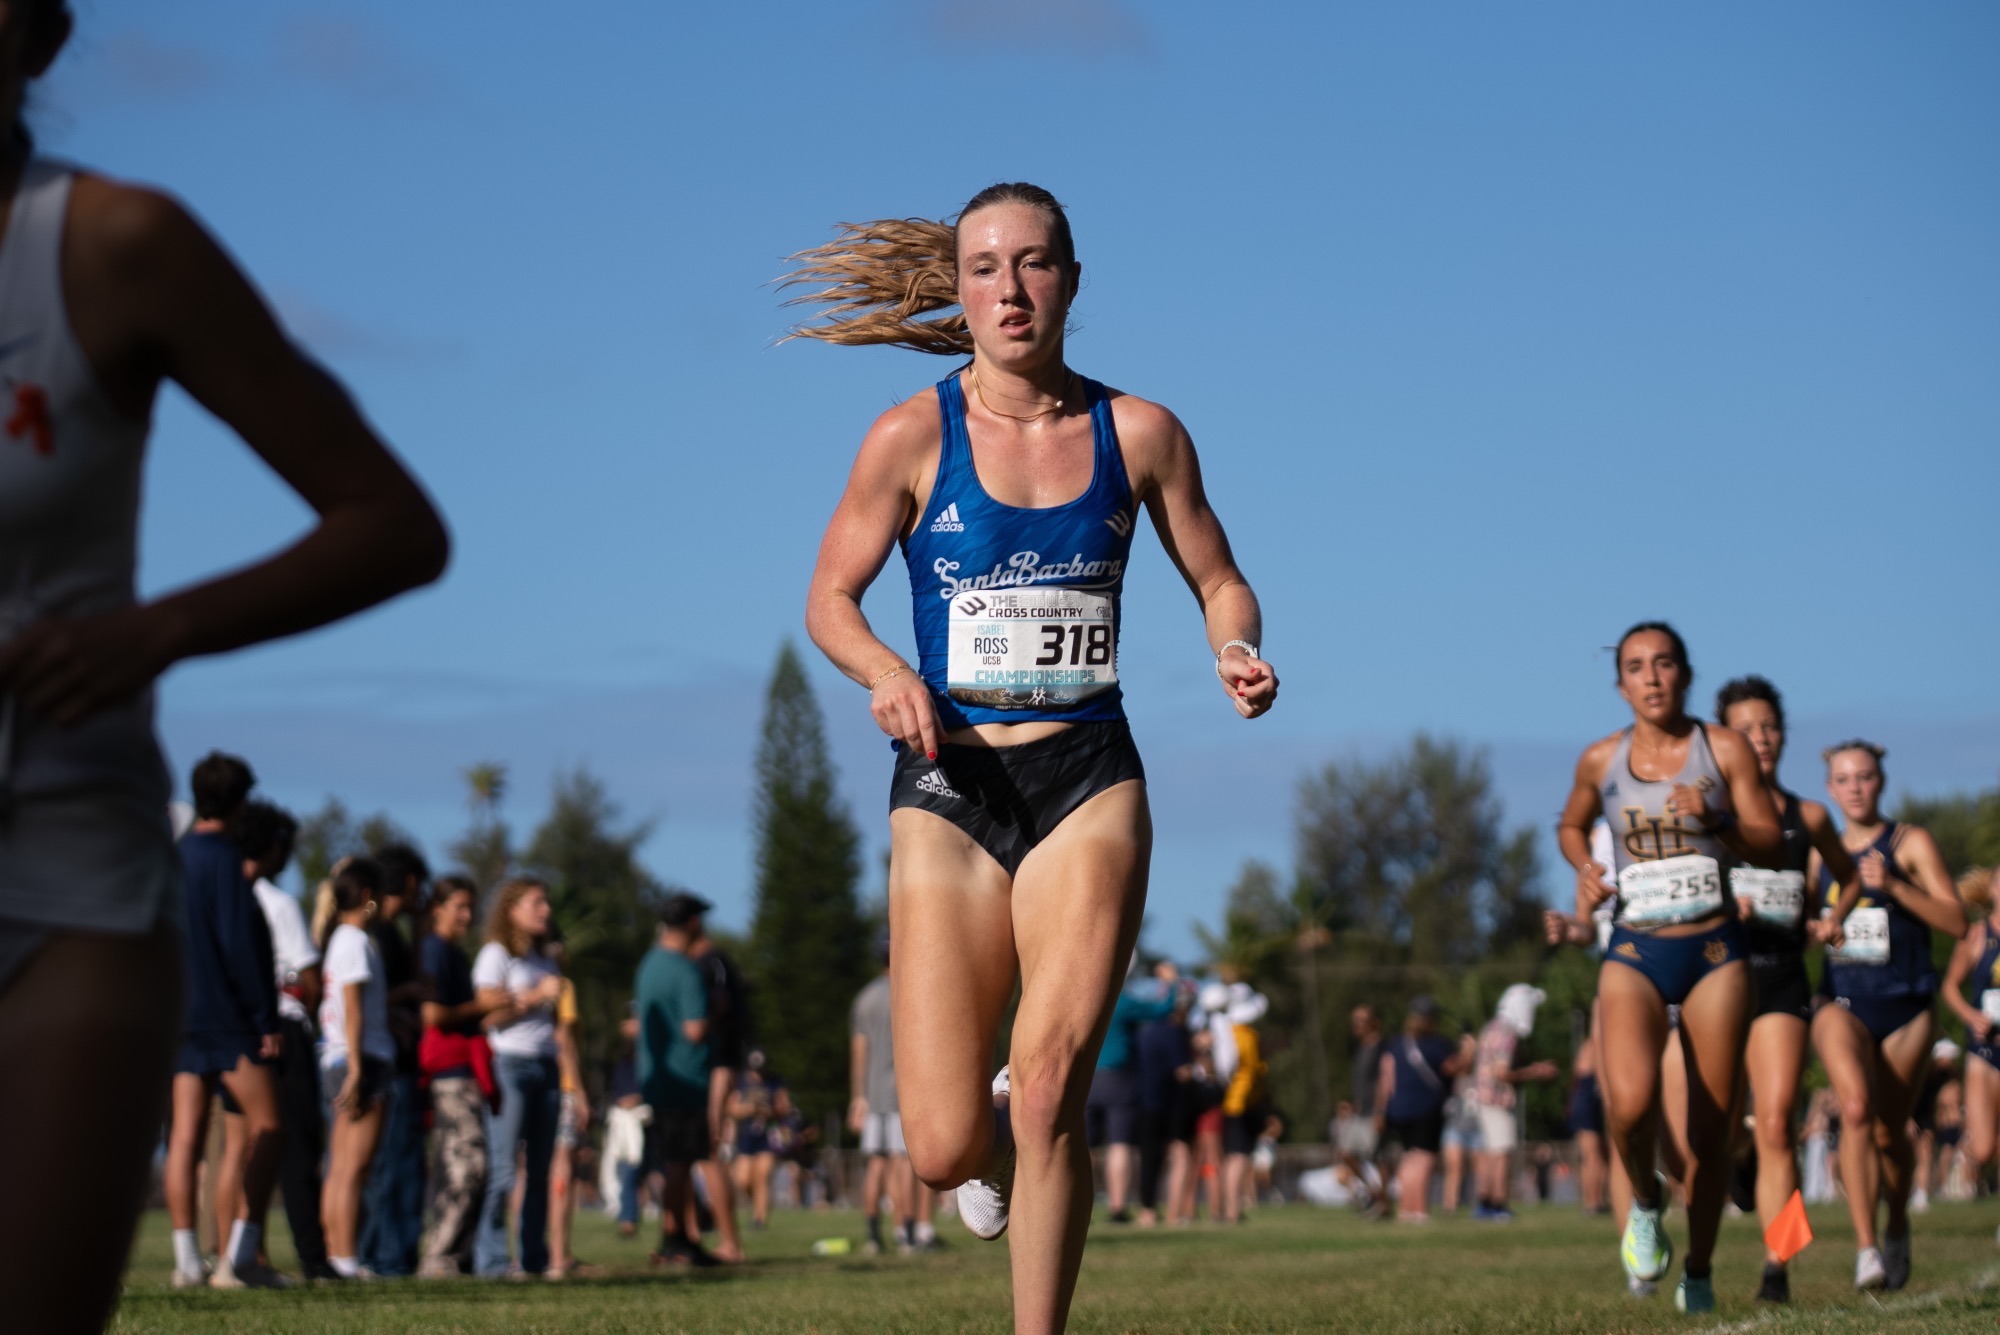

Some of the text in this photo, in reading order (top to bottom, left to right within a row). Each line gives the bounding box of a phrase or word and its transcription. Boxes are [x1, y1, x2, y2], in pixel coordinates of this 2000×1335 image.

[930, 520, 965, 532] adidas
[990, 595, 1018, 607] THE
[988, 607, 1084, 618] CROSS COUNTRY
[977, 624, 1006, 635] ISABEL
[974, 637, 1008, 654] ROSS
[1036, 624, 1111, 666] 318
[982, 656, 1002, 665] UCSB
[974, 669, 1096, 684] CHAMPIONSHIPS
[916, 779, 961, 799] adidas
[1669, 872, 1717, 900] 255
